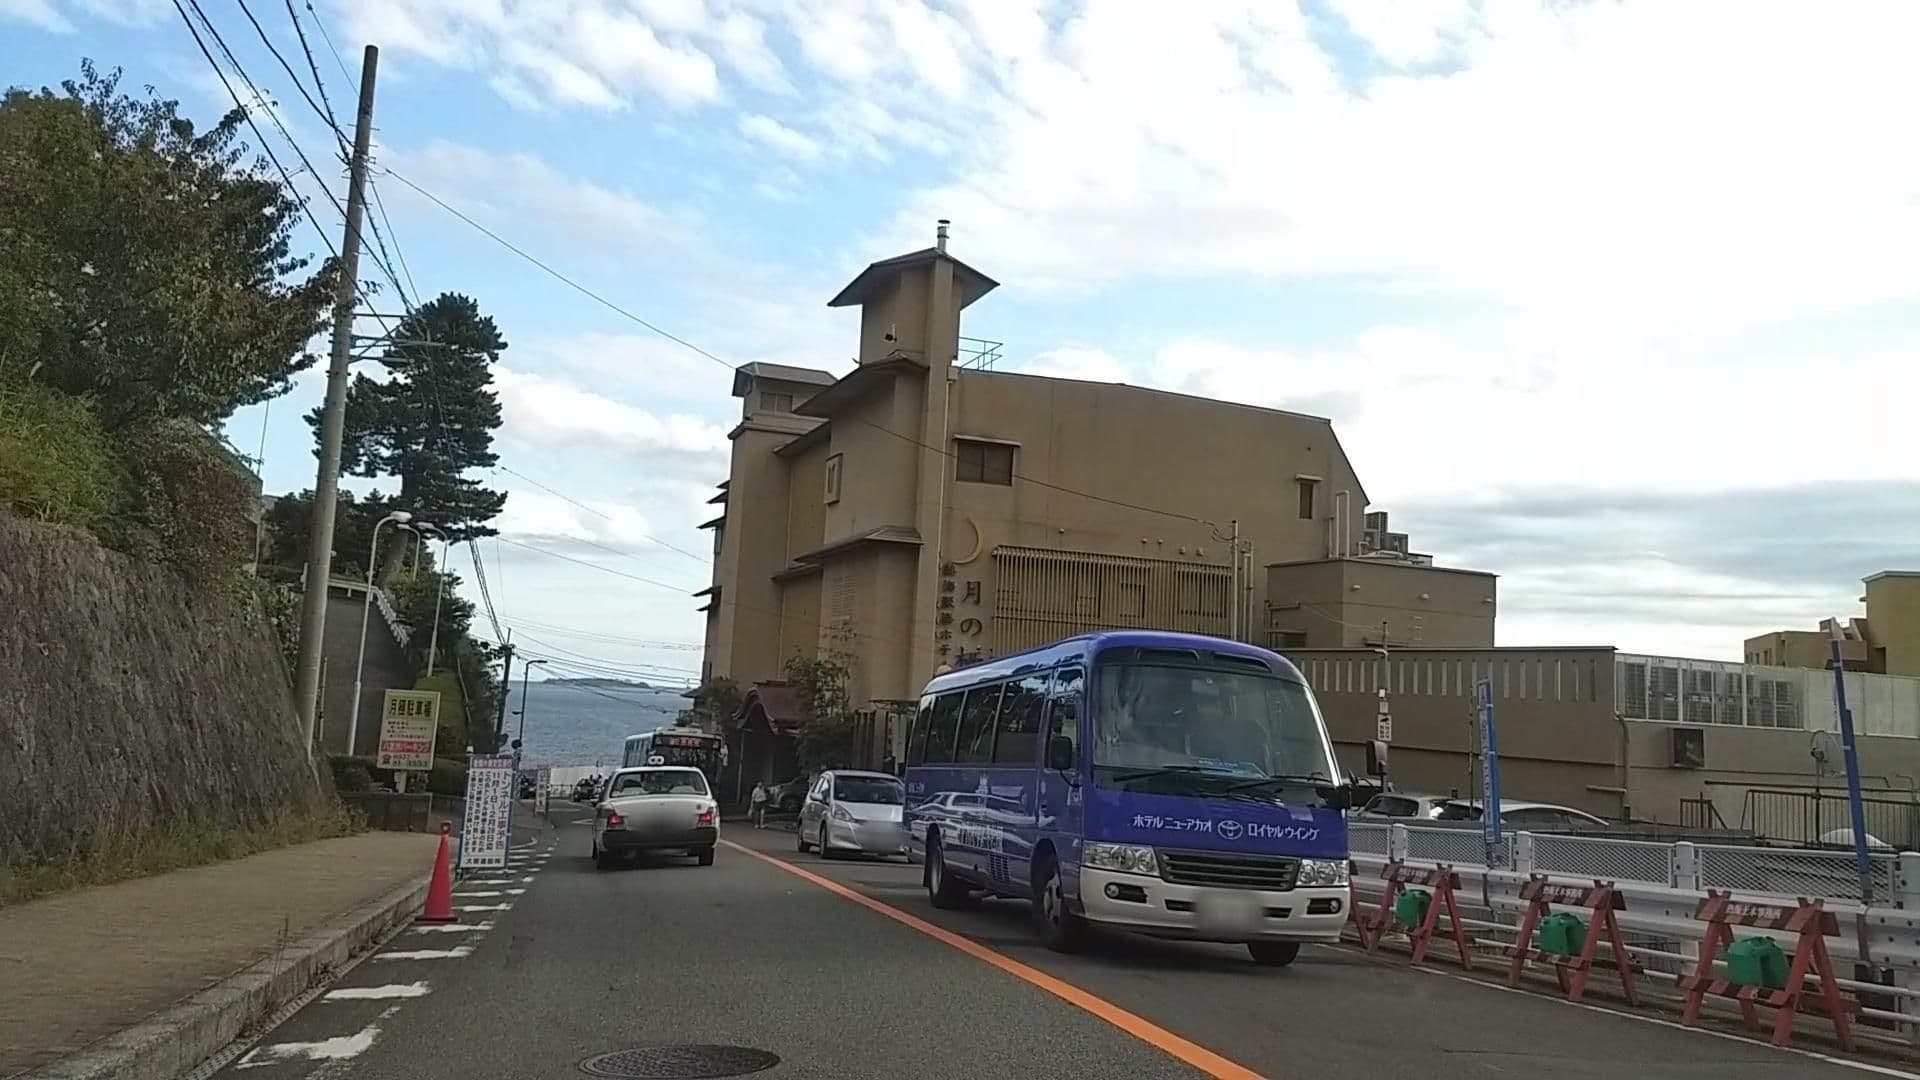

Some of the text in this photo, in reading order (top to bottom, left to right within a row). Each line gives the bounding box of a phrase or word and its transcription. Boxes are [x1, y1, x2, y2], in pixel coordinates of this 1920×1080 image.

[388, 698, 432, 718] 月極駐車場
[1133, 814, 1320, 841] ホテルニューアカオ ロイヤルウイング
